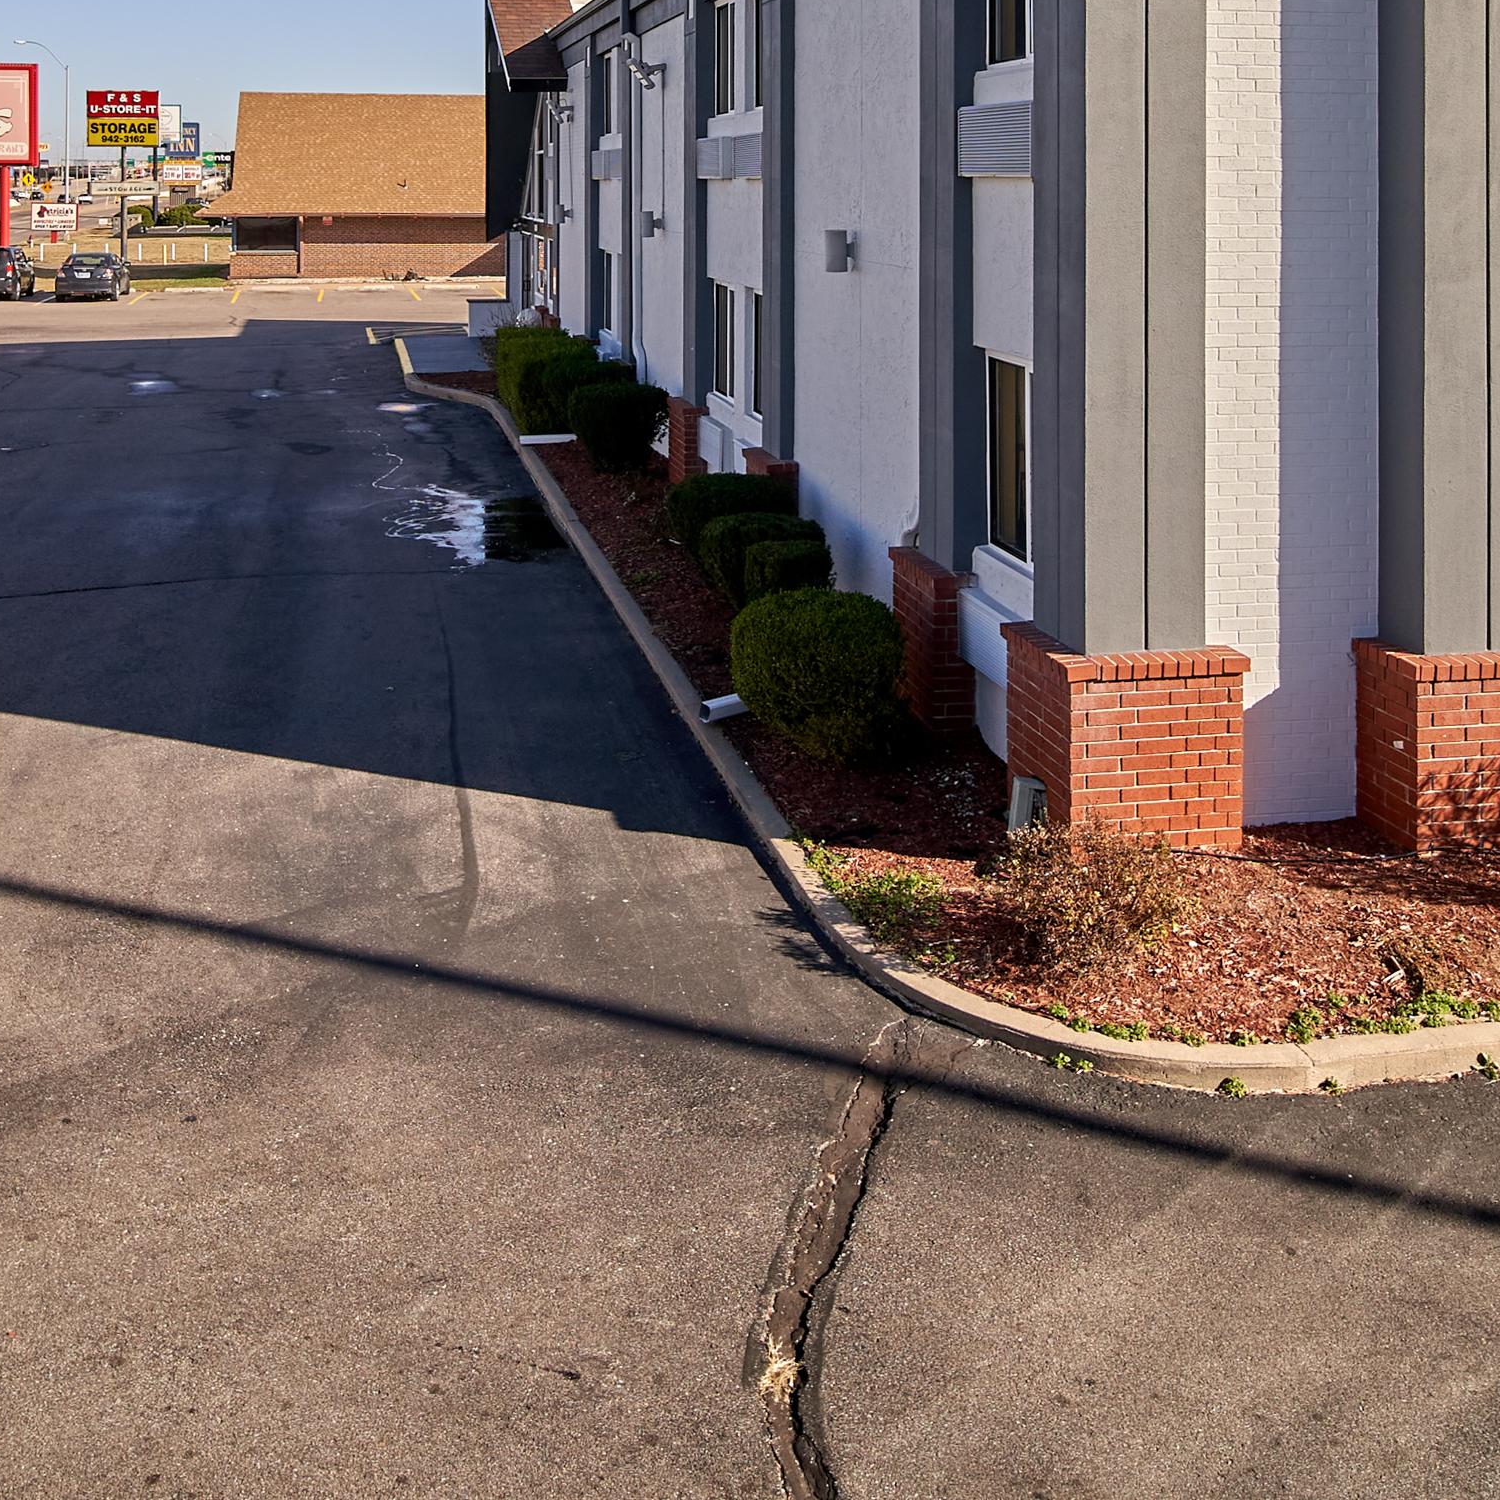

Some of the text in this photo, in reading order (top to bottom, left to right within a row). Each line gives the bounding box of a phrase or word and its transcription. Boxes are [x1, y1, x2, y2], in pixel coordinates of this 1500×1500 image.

[107, 94, 141, 102] F & S
[90, 105, 156, 113] U-STORE-IT
[90, 123, 156, 133] STORAGE
[101, 135, 145, 143] 942-3162
